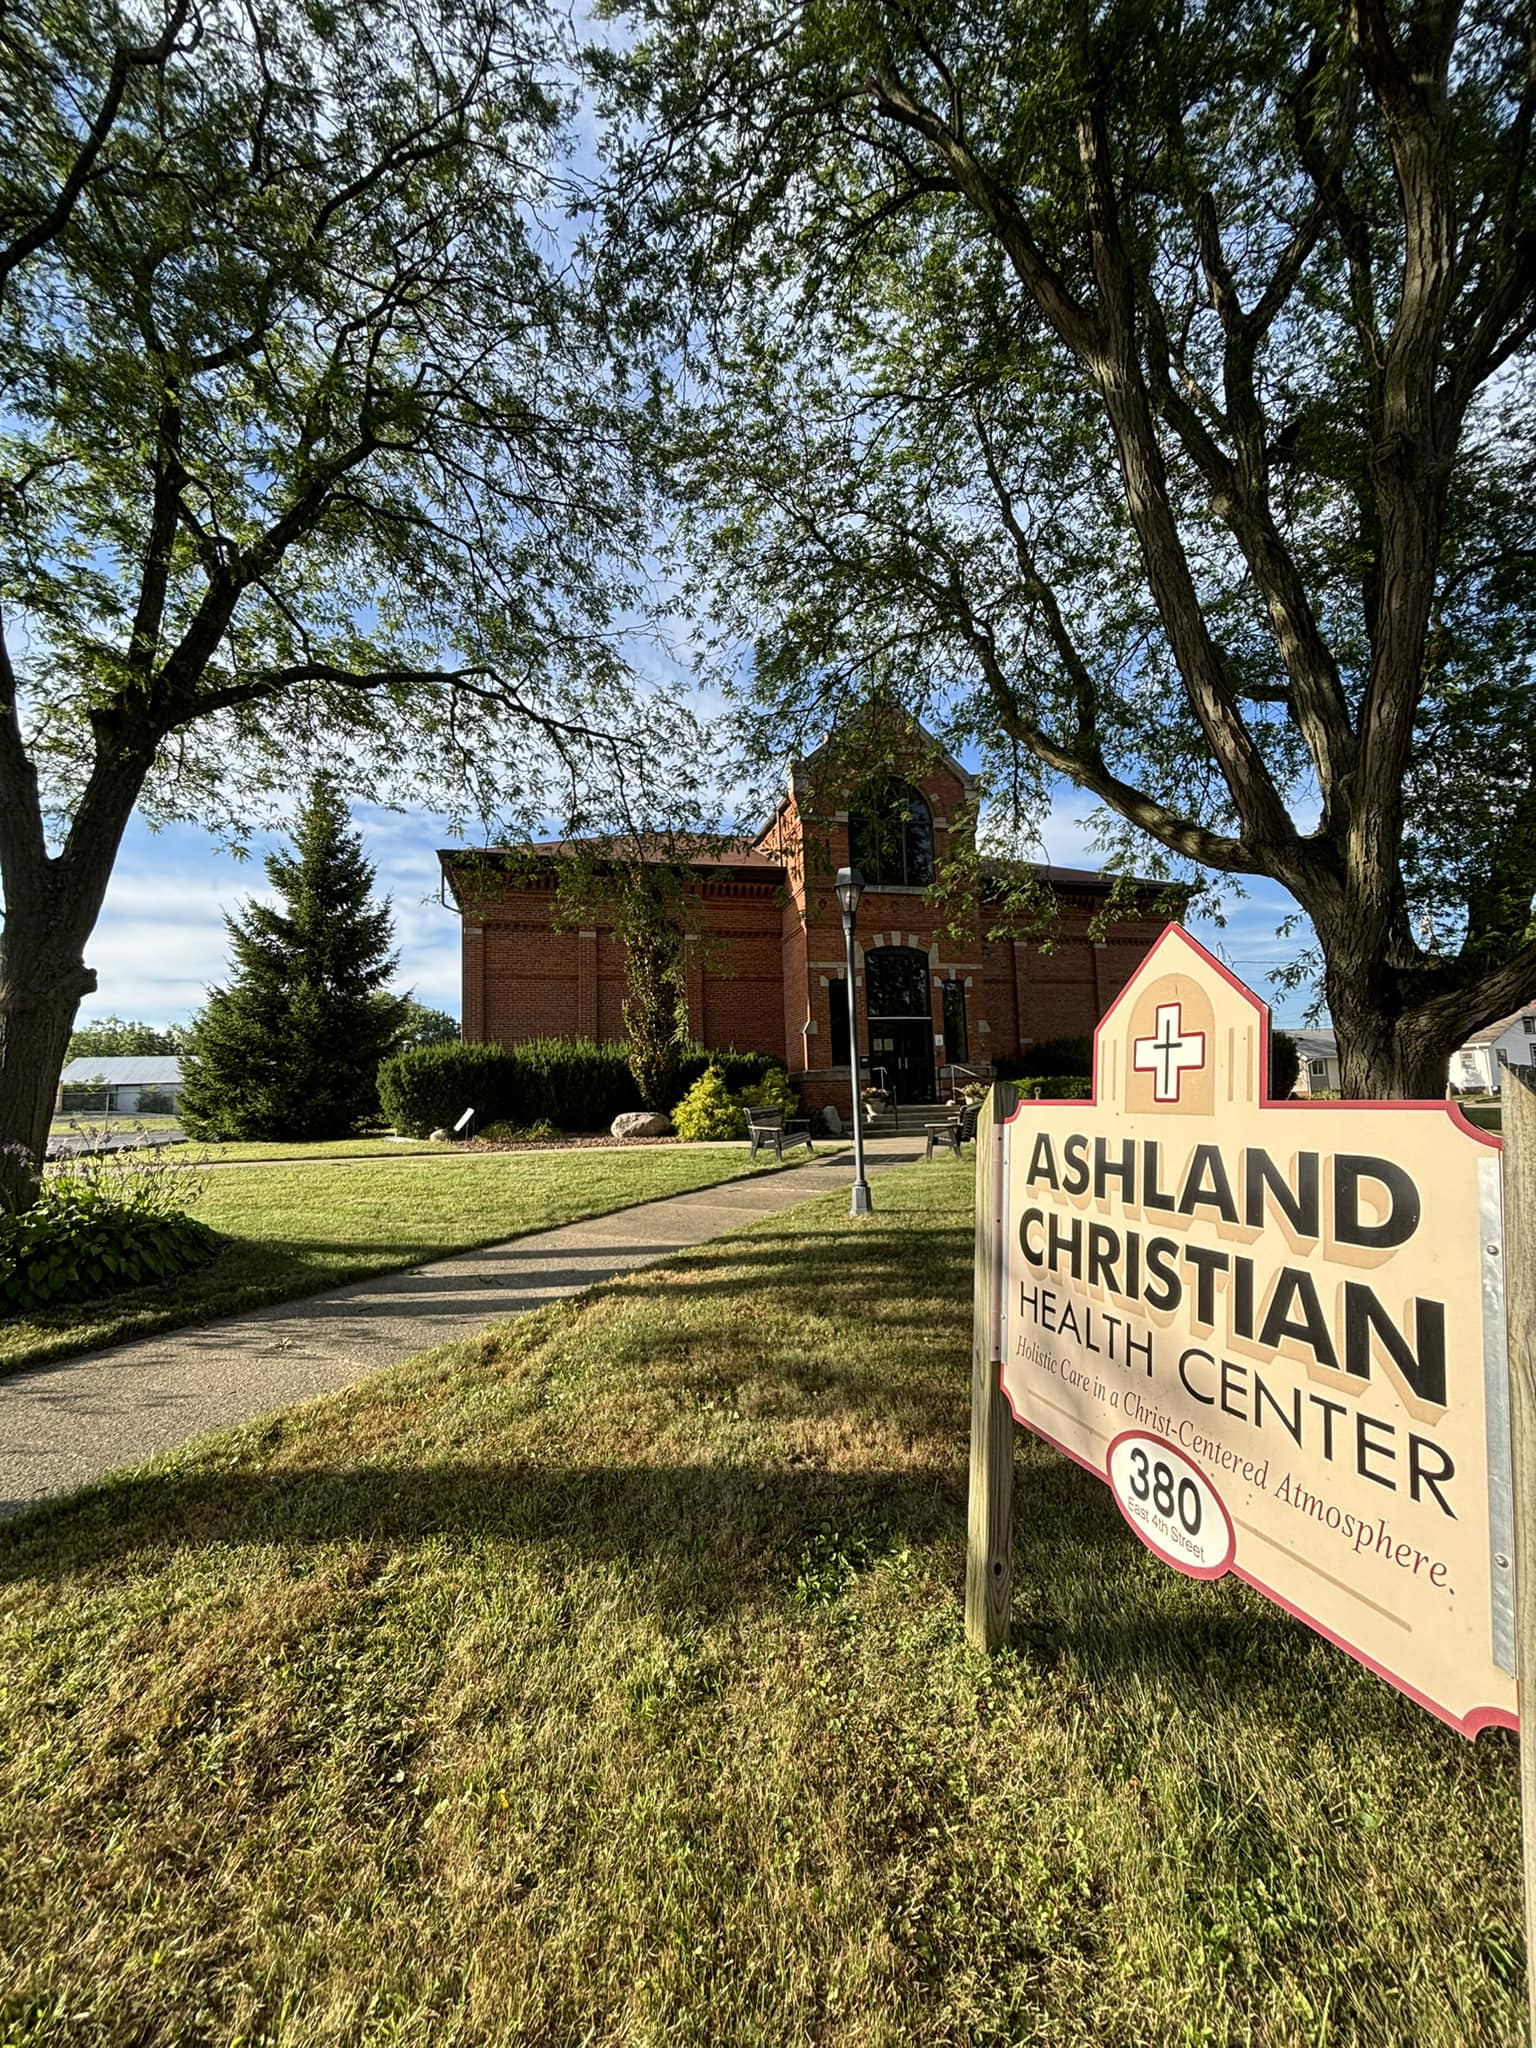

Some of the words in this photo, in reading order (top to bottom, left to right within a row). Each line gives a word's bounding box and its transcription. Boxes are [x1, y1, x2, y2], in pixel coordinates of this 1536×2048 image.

[1026, 1133, 1421, 1249] ASHLAND
[1019, 1207, 1446, 1407] CHRISTIAN
[1016, 1335, 1058, 1375] Holistic
[1060, 1358, 1090, 1392] Care
[1093, 1375, 1106, 1401] in
[1110, 1391, 1120, 1409] a
[1123, 1391, 1270, 1490] Christ-Centered
[1274, 1472, 1455, 1595] Atmosphere.
[1020, 1282, 1153, 1377] HEALTH
[1178, 1348, 1458, 1520] CENTER
[1127, 1495, 1150, 1524] East
[1151, 1514, 1169, 1536] 4th
[1171, 1525, 1206, 1564] Street
[1129, 1447, 1202, 1536] 380
